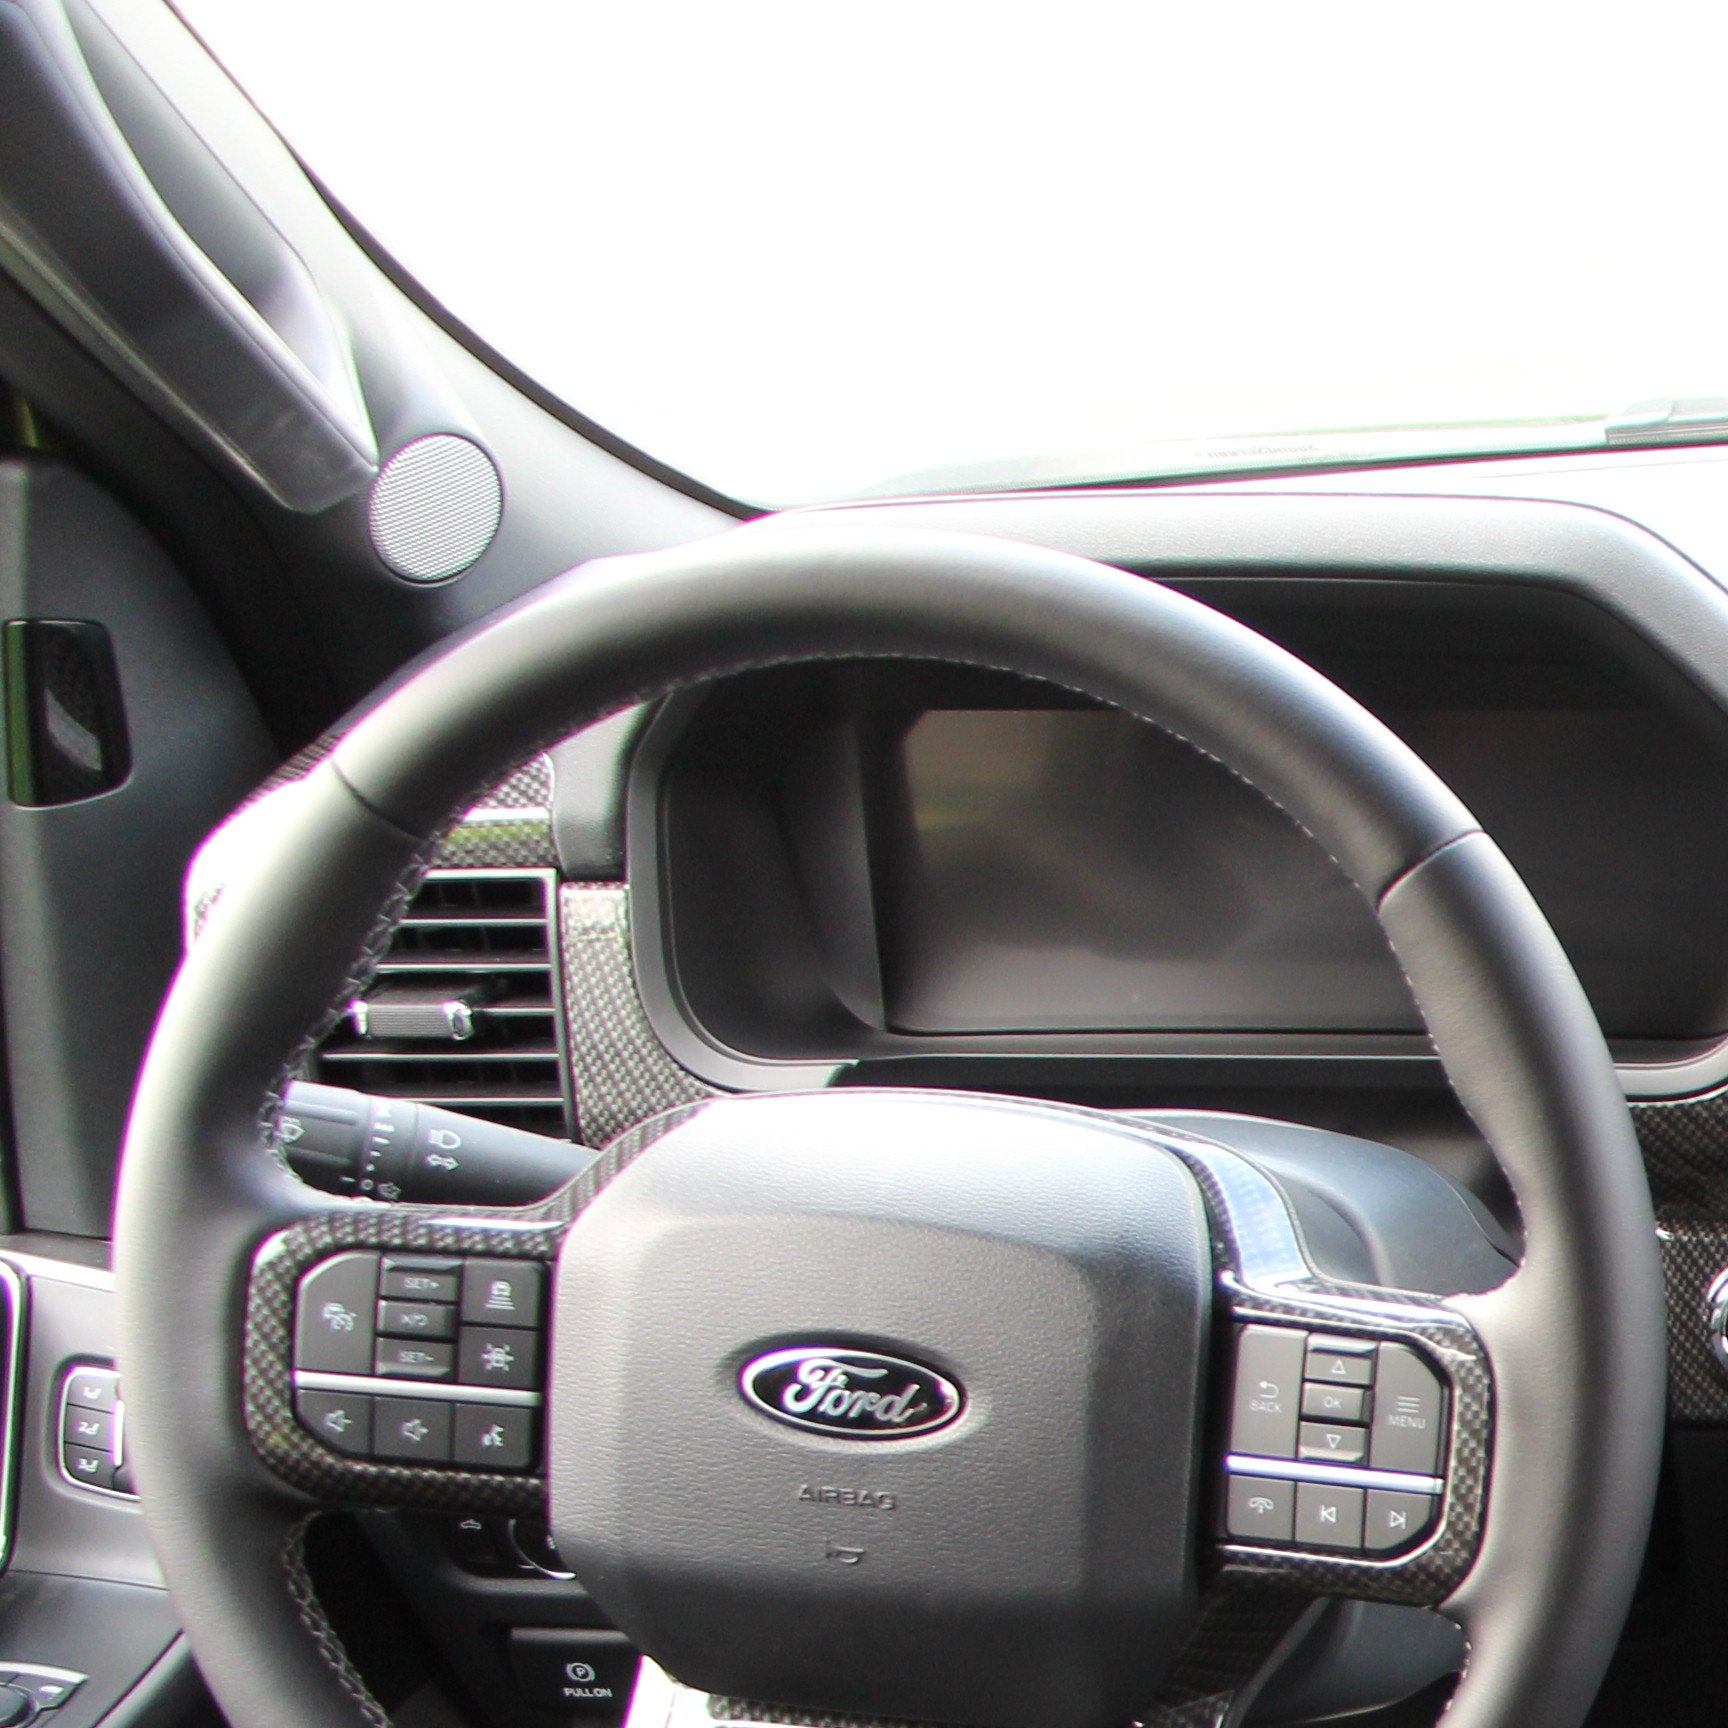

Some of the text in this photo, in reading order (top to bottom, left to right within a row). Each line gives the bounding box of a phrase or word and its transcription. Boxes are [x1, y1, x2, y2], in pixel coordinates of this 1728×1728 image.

[782, 1357, 927, 1423] Ford
[1250, 1400, 1282, 1413] BACK
[1323, 1396, 1343, 1409] OK
[1388, 1415, 1426, 1429] MENU
[799, 1484, 897, 1510] AIRBAG
[563, 1687, 613, 1697] PULL ON
